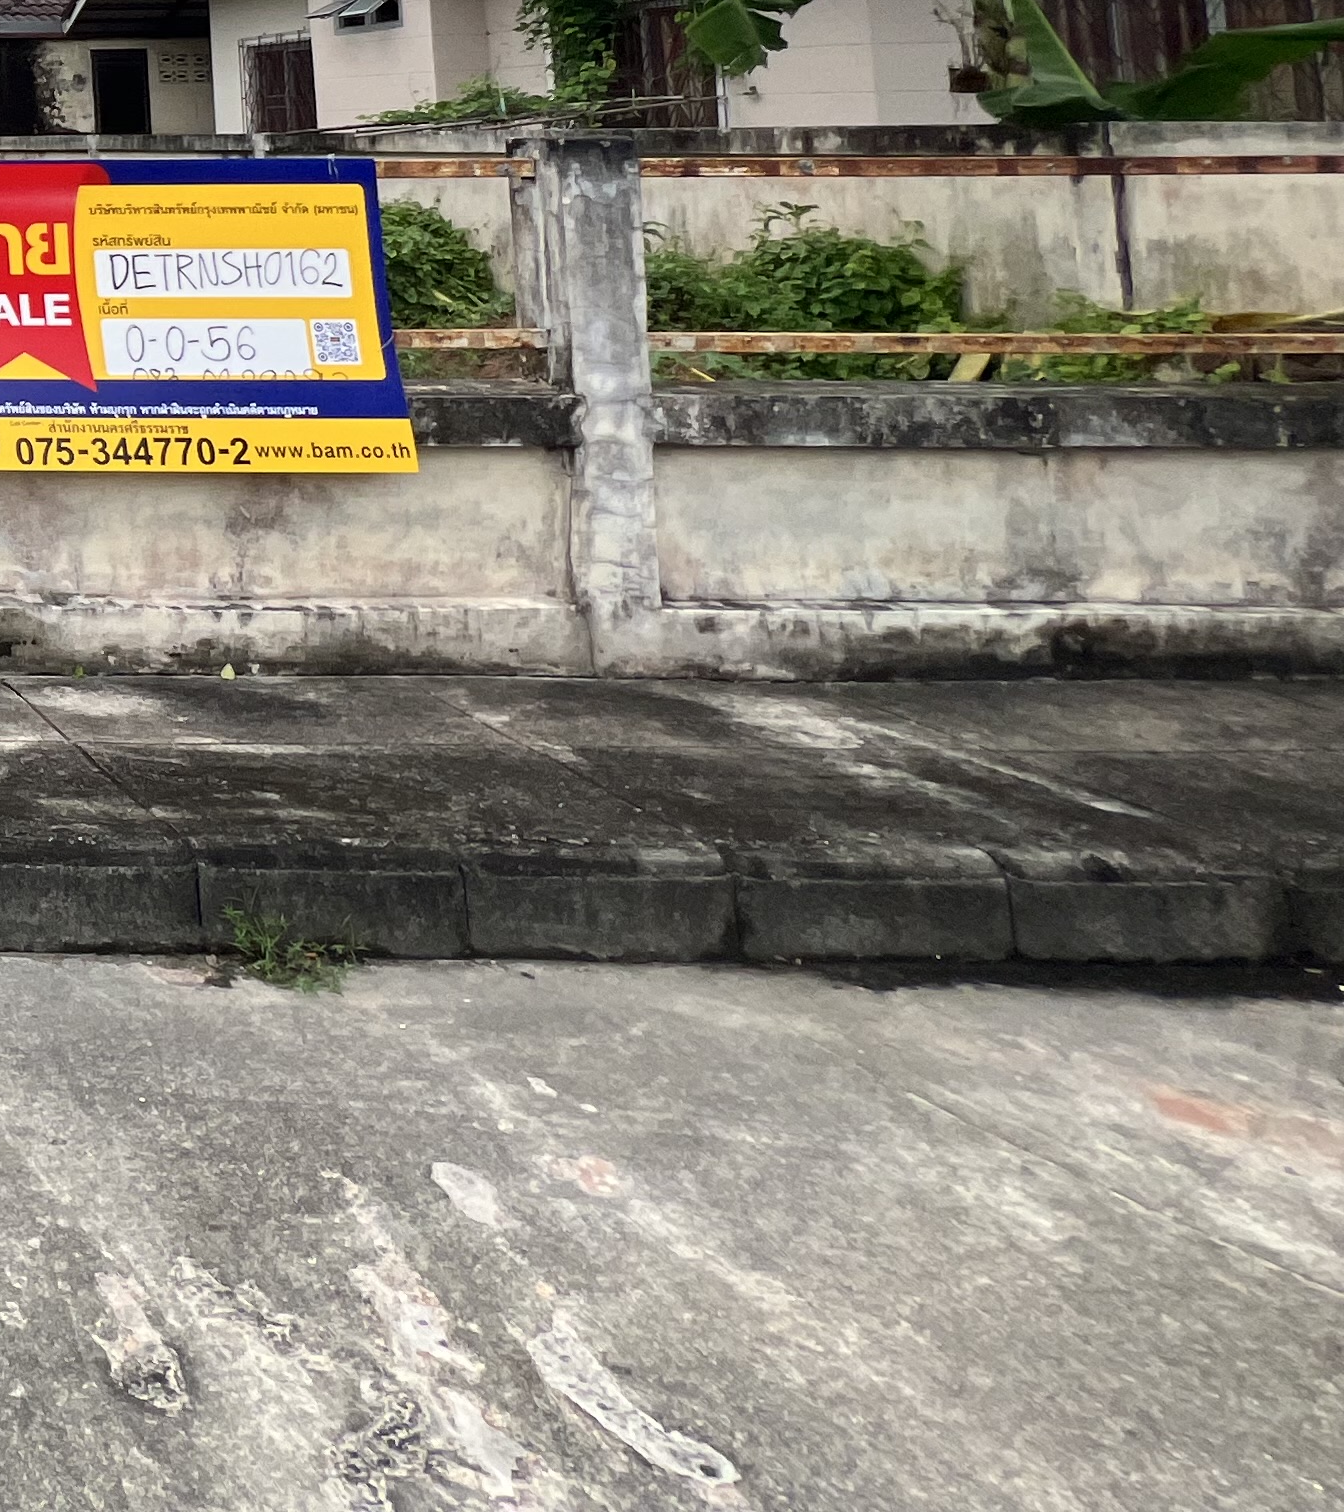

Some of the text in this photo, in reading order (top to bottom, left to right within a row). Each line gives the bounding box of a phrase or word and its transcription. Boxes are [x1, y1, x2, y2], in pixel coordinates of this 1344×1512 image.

[282, 201, 310, 214] จำกัด
[313, 204, 358, 216] (มหาชน)
[92, 234, 171, 247] รหัสทรัพย์สิน
[97, 298, 129, 315] เนื้อที่
[125, 324, 257, 363] 0-0-56
[48, 419, 189, 435] สำนักงานนครศรีธรรมราช
[16, 437, 412, 466] 075-344770-2 www.bam.co.th
